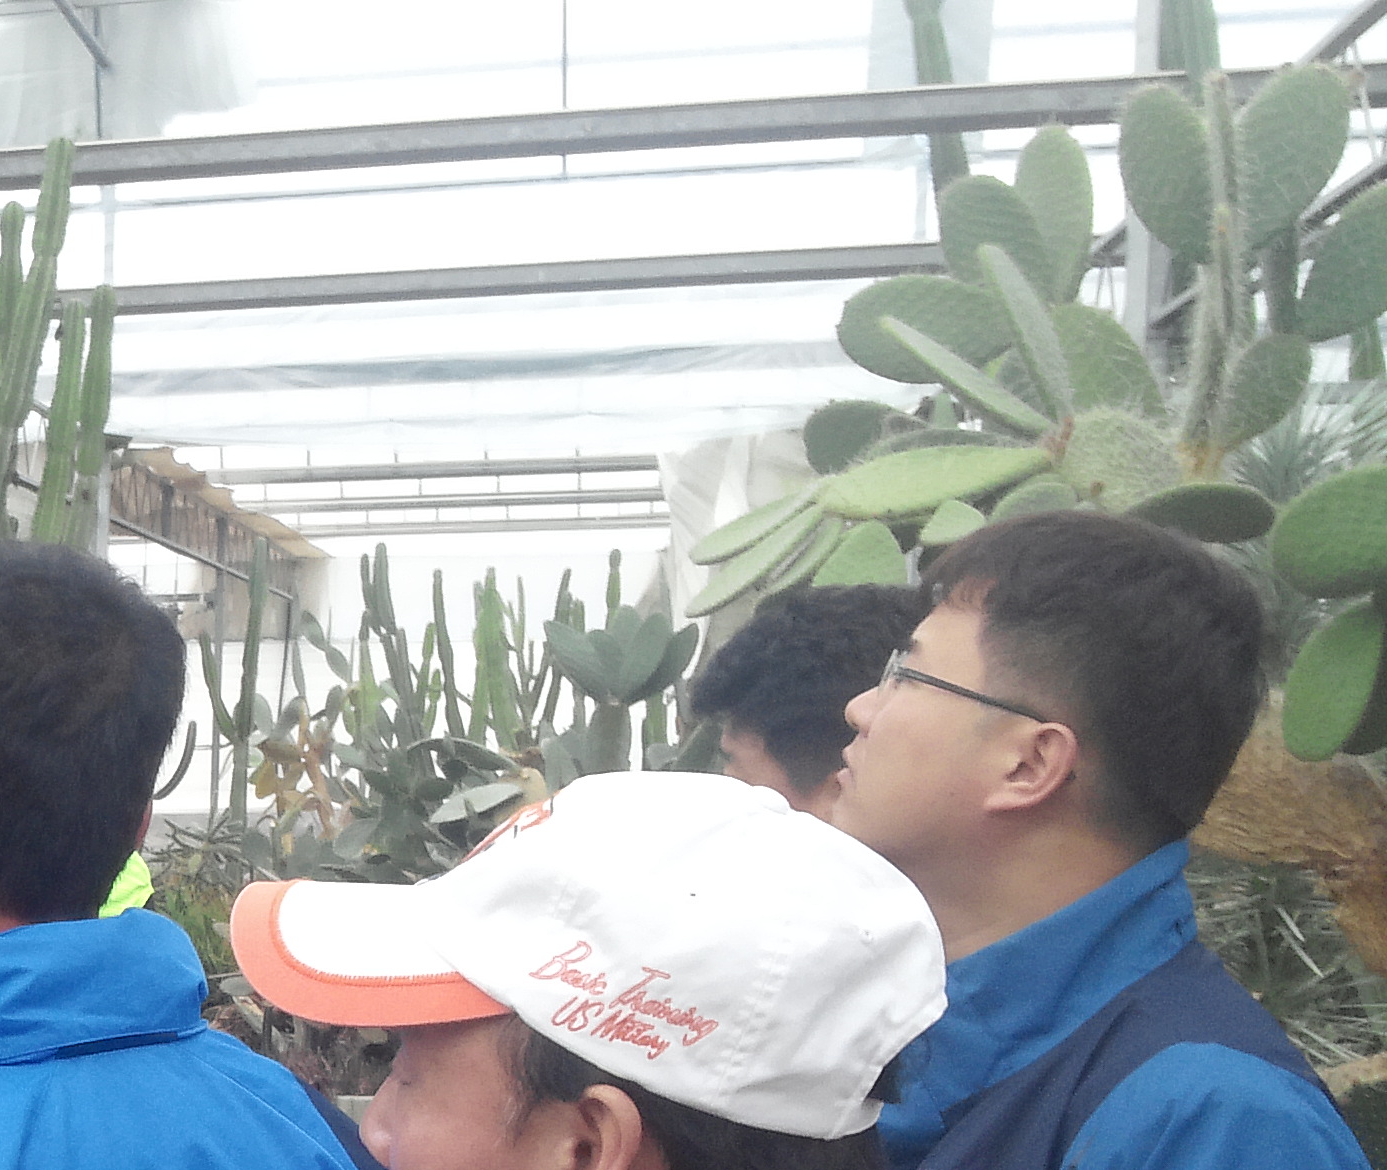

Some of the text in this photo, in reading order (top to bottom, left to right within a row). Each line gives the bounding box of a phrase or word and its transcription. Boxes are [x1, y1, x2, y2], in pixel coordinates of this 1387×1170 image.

[528, 940, 719, 1047] Basic Training
[551, 996, 671, 1060] US Military
